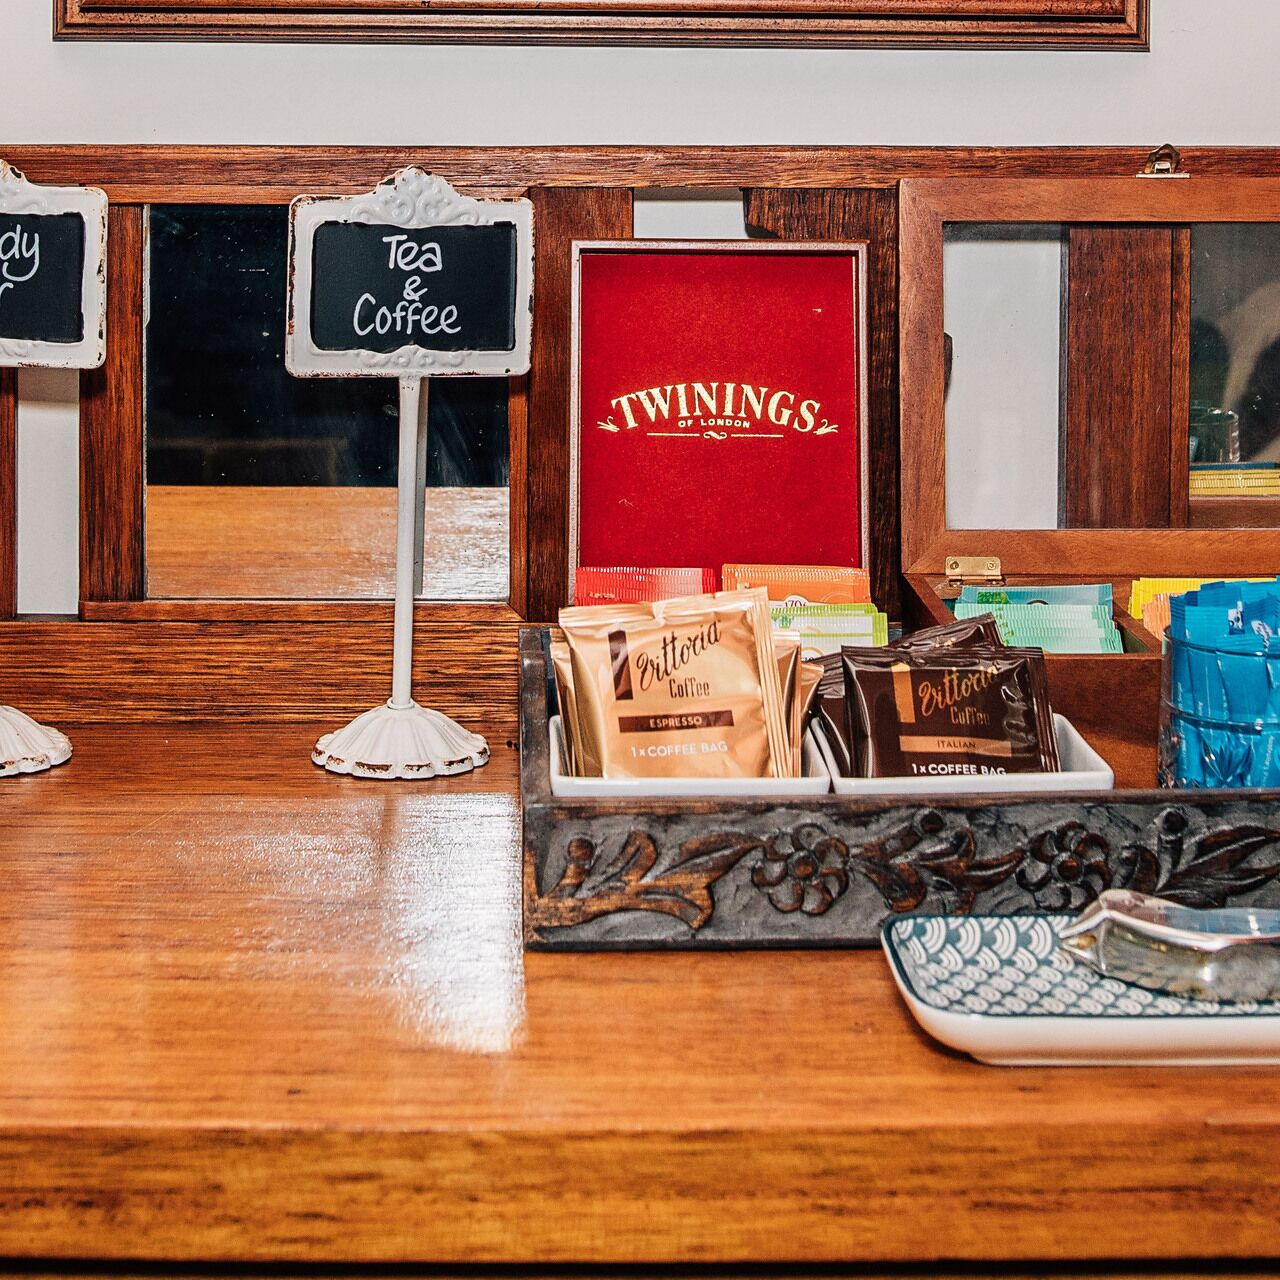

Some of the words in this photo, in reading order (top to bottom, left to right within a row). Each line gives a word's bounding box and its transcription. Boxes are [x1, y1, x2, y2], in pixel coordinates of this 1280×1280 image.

[382, 235, 443, 272] Tea
[403, 275, 428, 301] &
[353, 293, 461, 336] Coffee
[611, 382, 820, 432] TWININGS
[677, 418, 694, 428] OF
[700, 418, 751, 429] LONDON
[636, 620, 722, 691] Vittoria
[669, 676, 710, 699] Coffee
[918, 663, 1002, 717] Vittoria
[649, 716, 703, 729] ESPRESSO
[950, 705, 990, 727] Coffee
[647, 743, 697, 757] COFFEE
[701, 741, 728, 753] BAG
[937, 739, 977, 750] ITALIAN
[928, 763, 978, 776] COFFEE
[981, 765, 1007, 777] BAG
